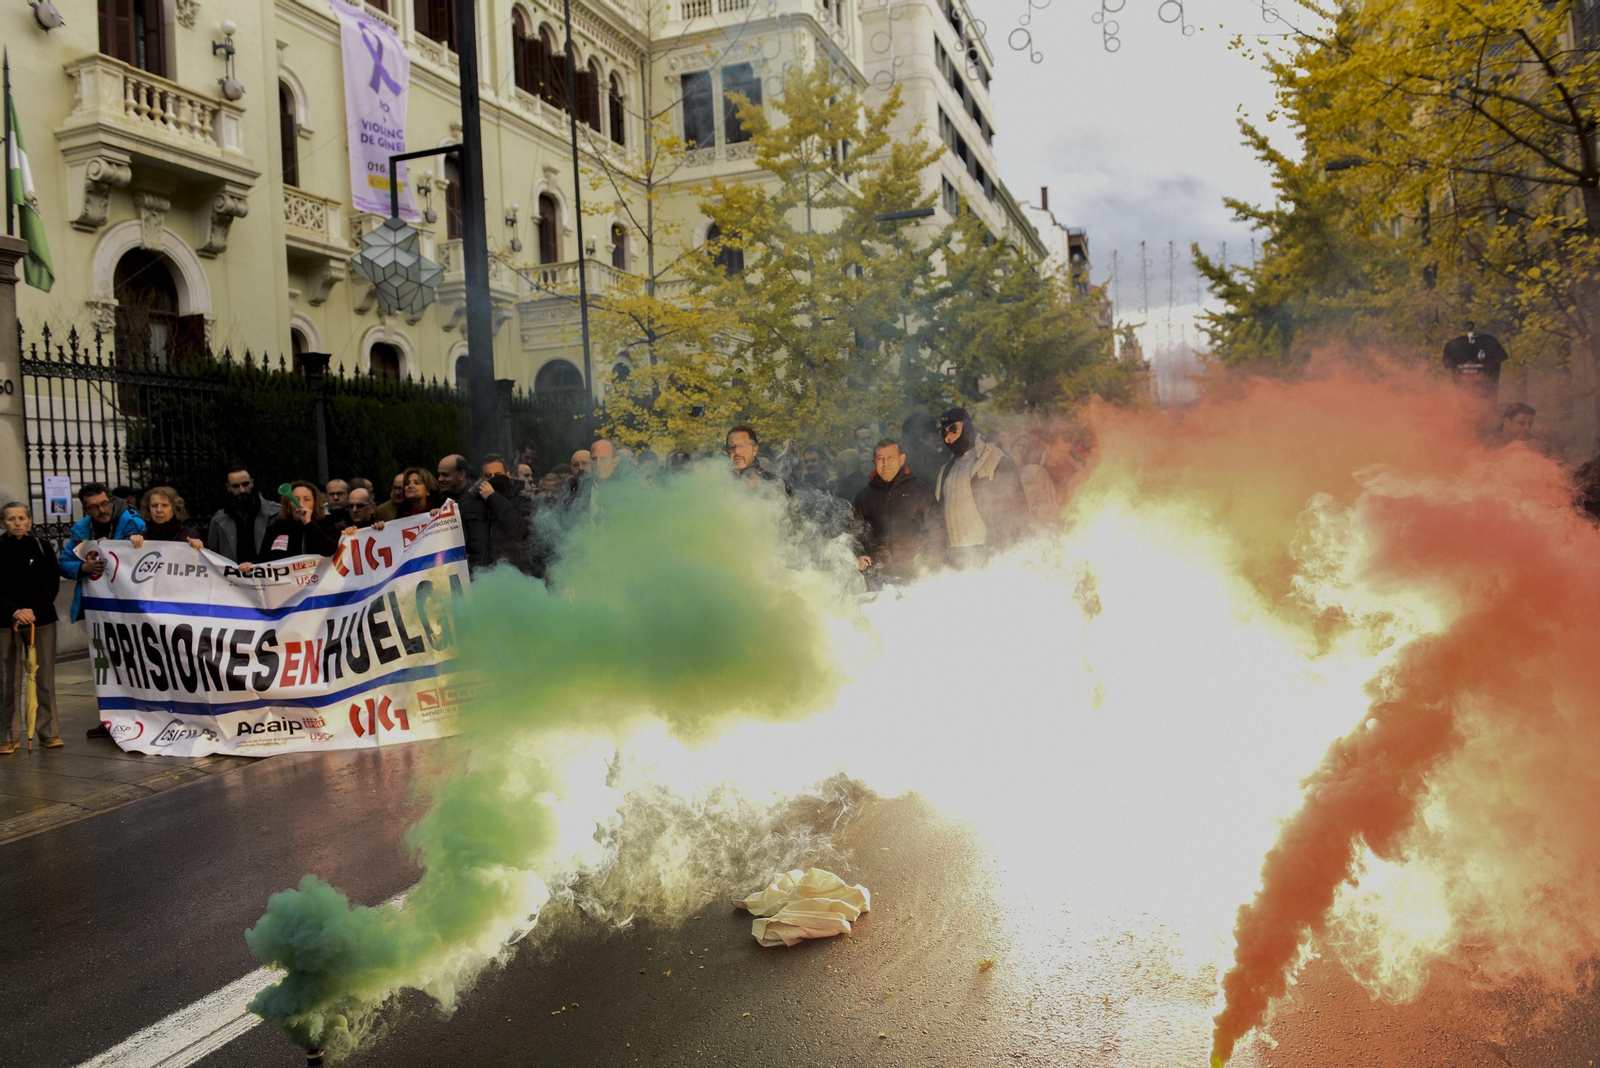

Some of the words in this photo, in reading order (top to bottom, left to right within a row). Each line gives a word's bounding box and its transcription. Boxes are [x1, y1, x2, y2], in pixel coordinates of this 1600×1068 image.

[360, 132, 375, 145] DE
[367, 161, 385, 173] 016
[138, 560, 165, 574] CSIF
[223, 564, 289, 581] Acaip
[280, 638, 323, 687] EN
[349, 695, 410, 738] CIG
[237, 717, 302, 736] Acaip
